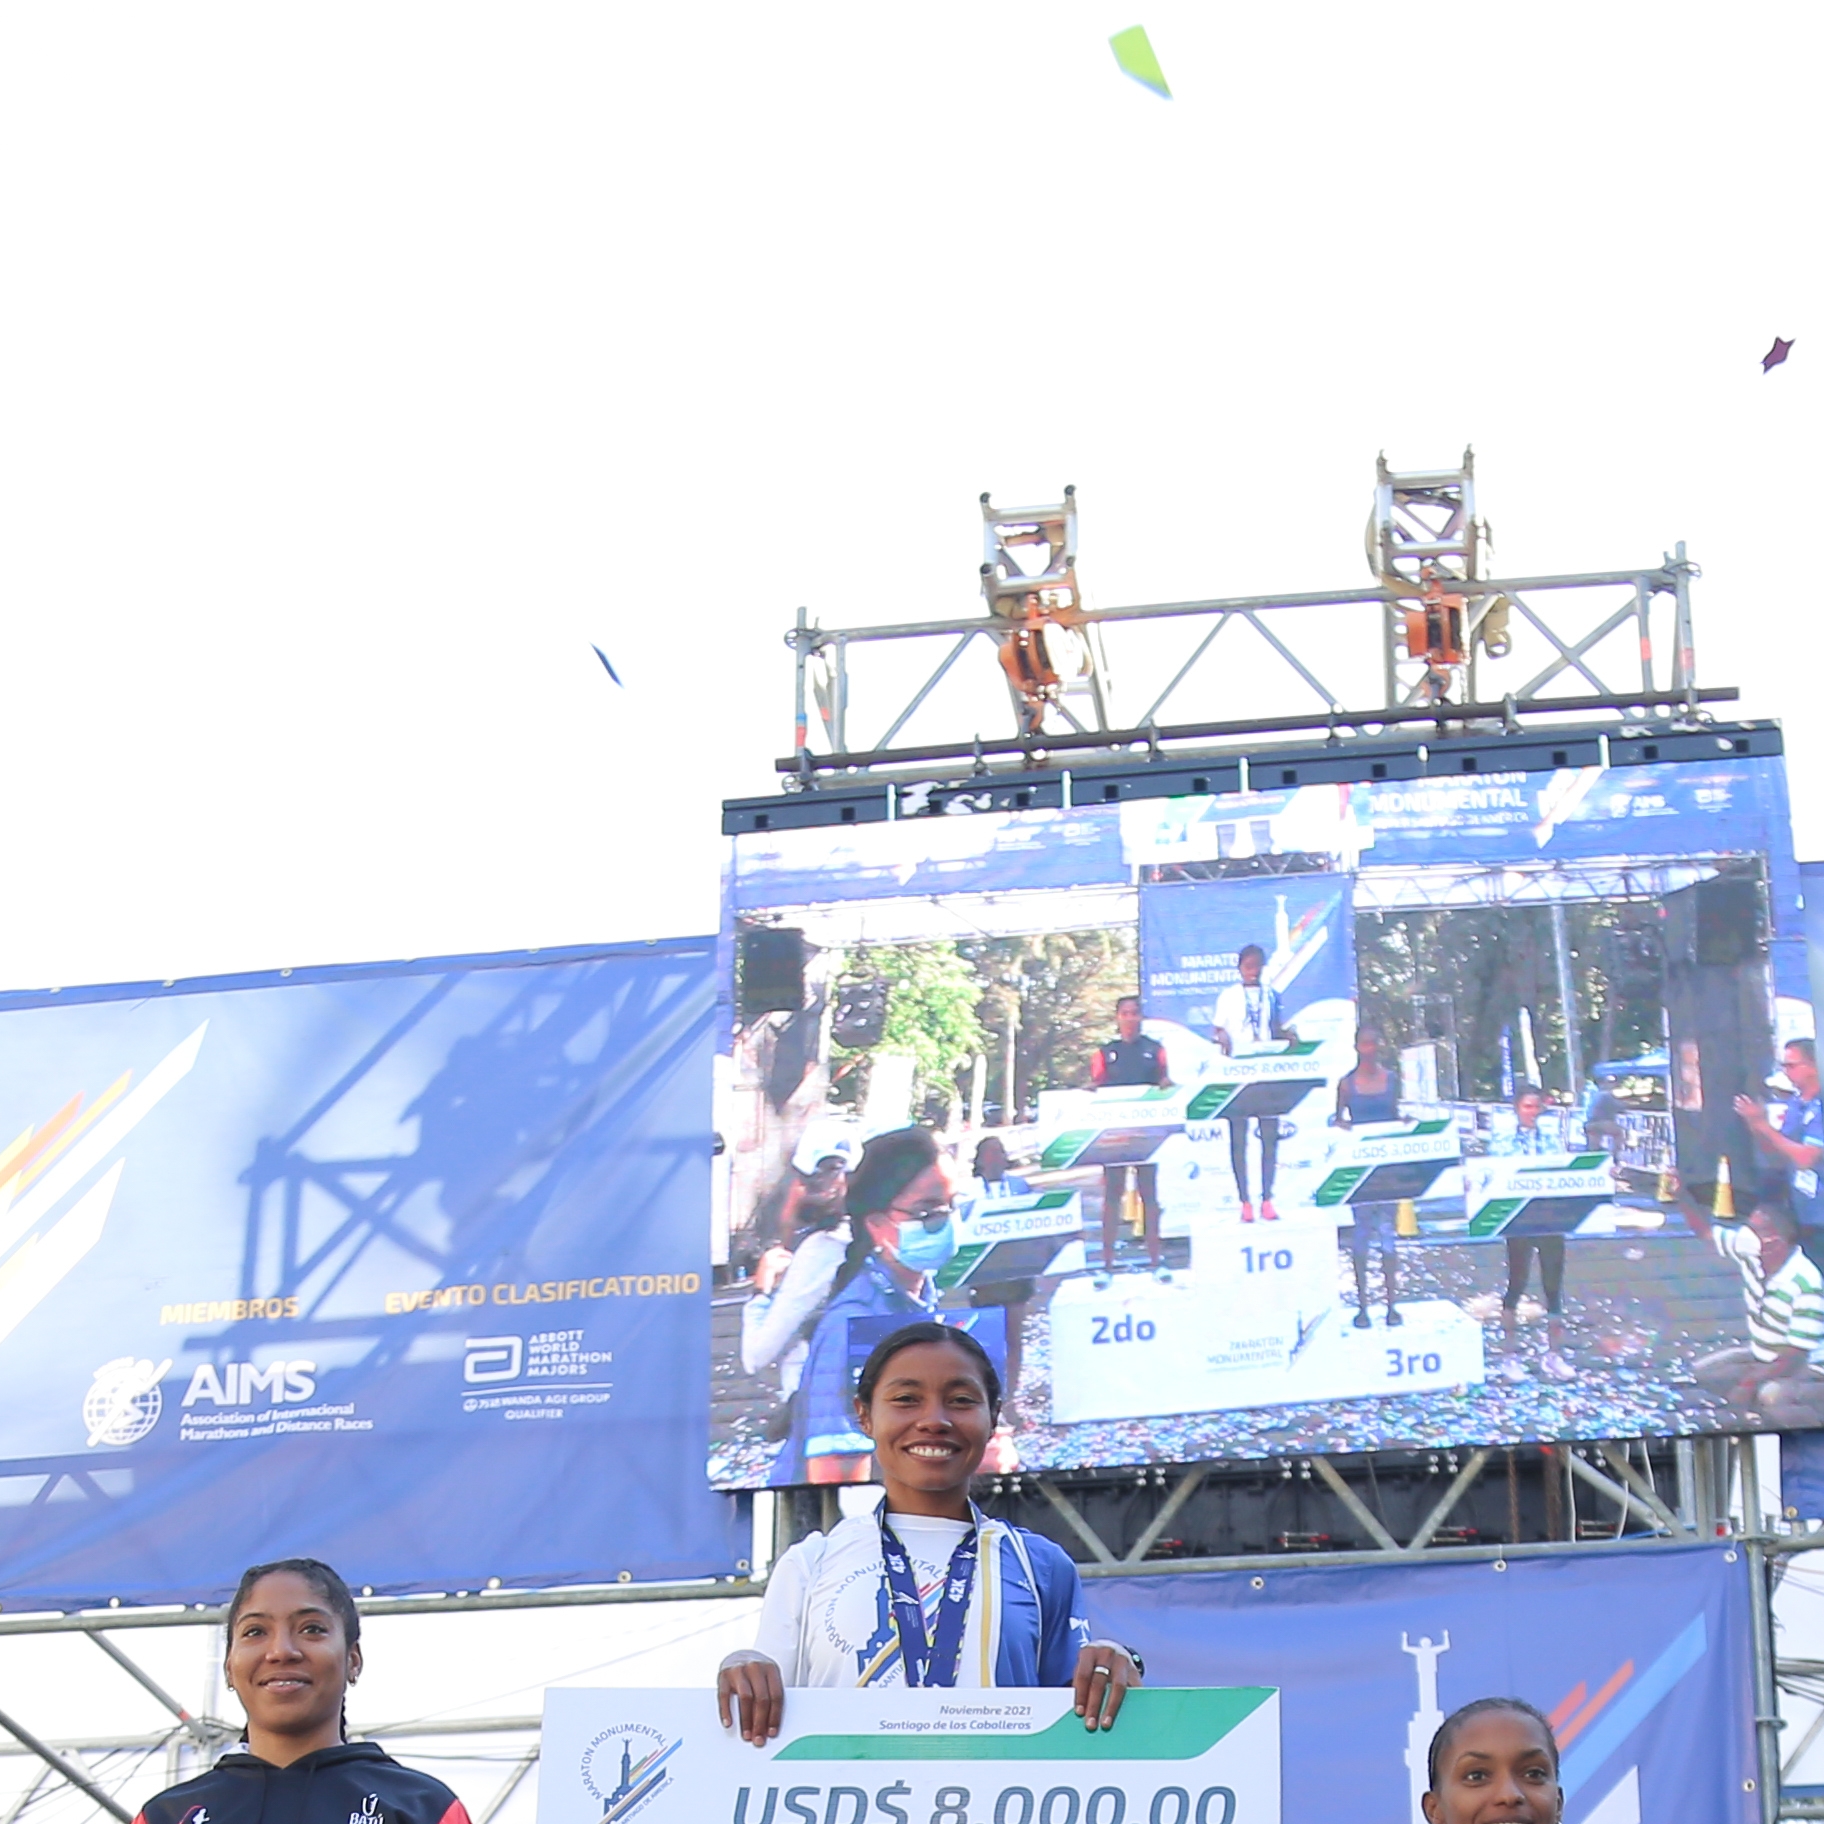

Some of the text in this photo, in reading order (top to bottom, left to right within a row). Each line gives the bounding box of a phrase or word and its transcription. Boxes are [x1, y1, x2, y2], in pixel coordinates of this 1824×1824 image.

[1239, 1244, 1294, 1274] 1ro
[384, 1273, 701, 1314] EVENTO CLASIFICATORIO
[160, 1296, 299, 1325] MIEMBROS
[529, 1330, 584, 1344] ABBOTT
[1091, 1314, 1156, 1344] 2do
[528, 1352, 612, 1365] MARATHON
[529, 1342, 579, 1354] WORLD
[528, 1364, 588, 1376] MAJORS
[1386, 1348, 1442, 1376] 3ro
[181, 1360, 316, 1406] AIMS
[180, 1402, 354, 1426] Association Internacional
[180, 1418, 373, 1440] Marathons and Distance Races
[887, 1554, 906, 1573] 42K
[948, 1578, 967, 1603] 42K
[940, 1706, 1031, 1715] Noviembre 2021
[879, 1720, 930, 1731] Santiago
[933, 1720, 947, 1730] de
[950, 1720, 966, 1730] los
